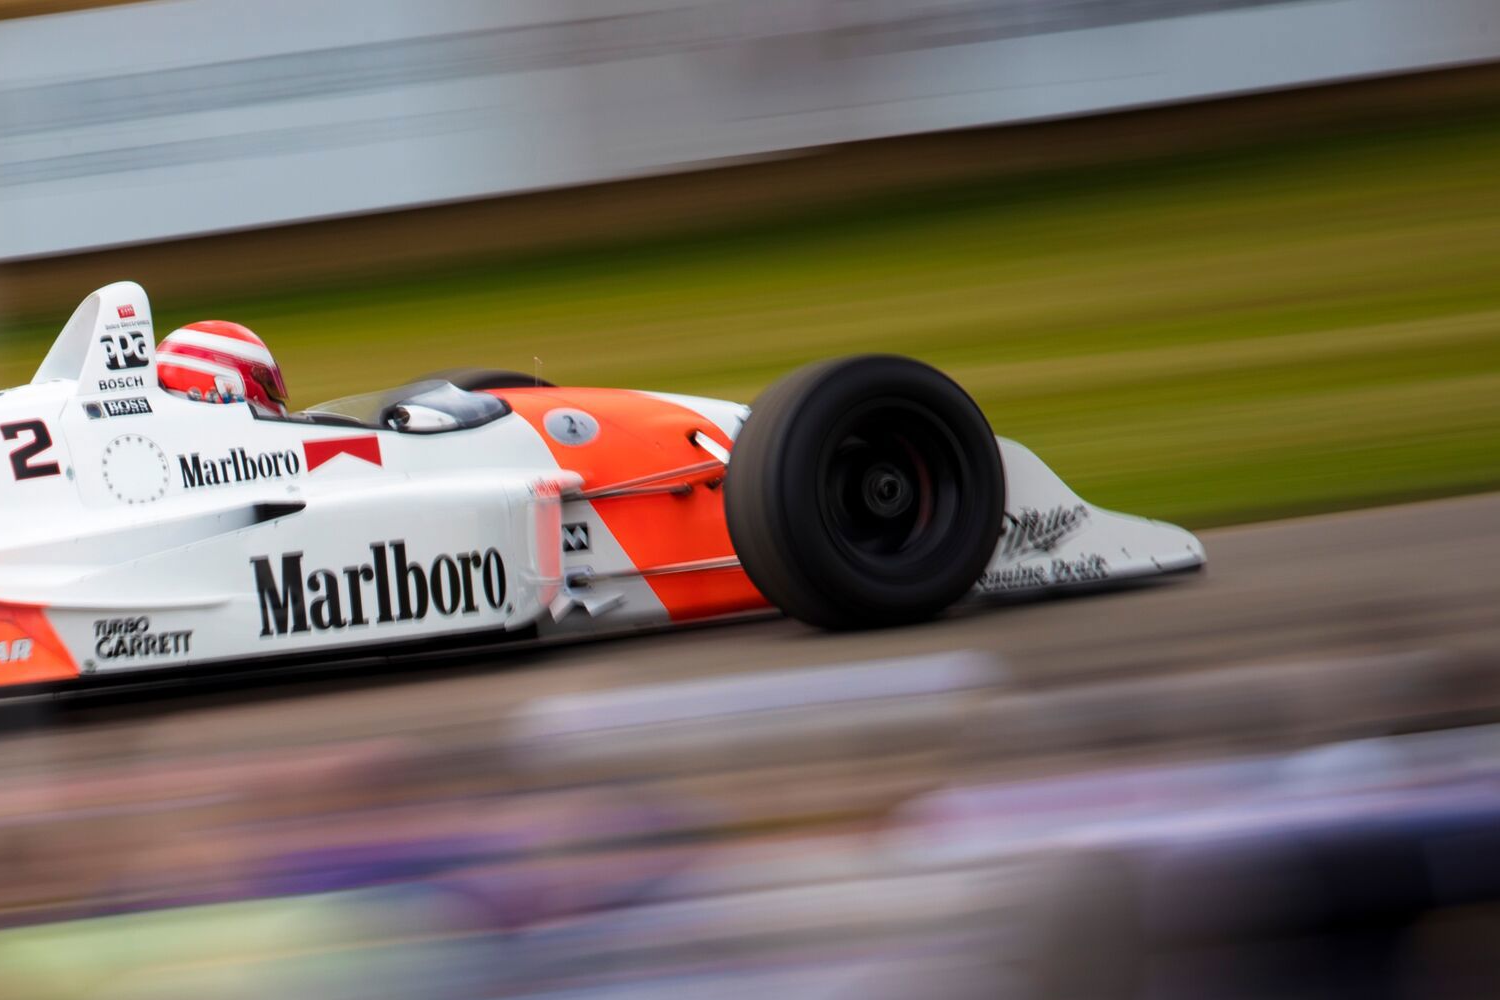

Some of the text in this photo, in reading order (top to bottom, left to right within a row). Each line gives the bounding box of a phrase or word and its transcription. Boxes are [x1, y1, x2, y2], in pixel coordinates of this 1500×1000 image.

[100, 331, 150, 370] PPG
[99, 376, 145, 391] BOSCH
[106, 398, 150, 415] BOSS
[0, 418, 61, 481] 2
[178, 446, 300, 489] Marlboro
[249, 540, 506, 638] Marlboro
[93, 615, 150, 637] TURBO
[95, 628, 193, 659] GARRETT
